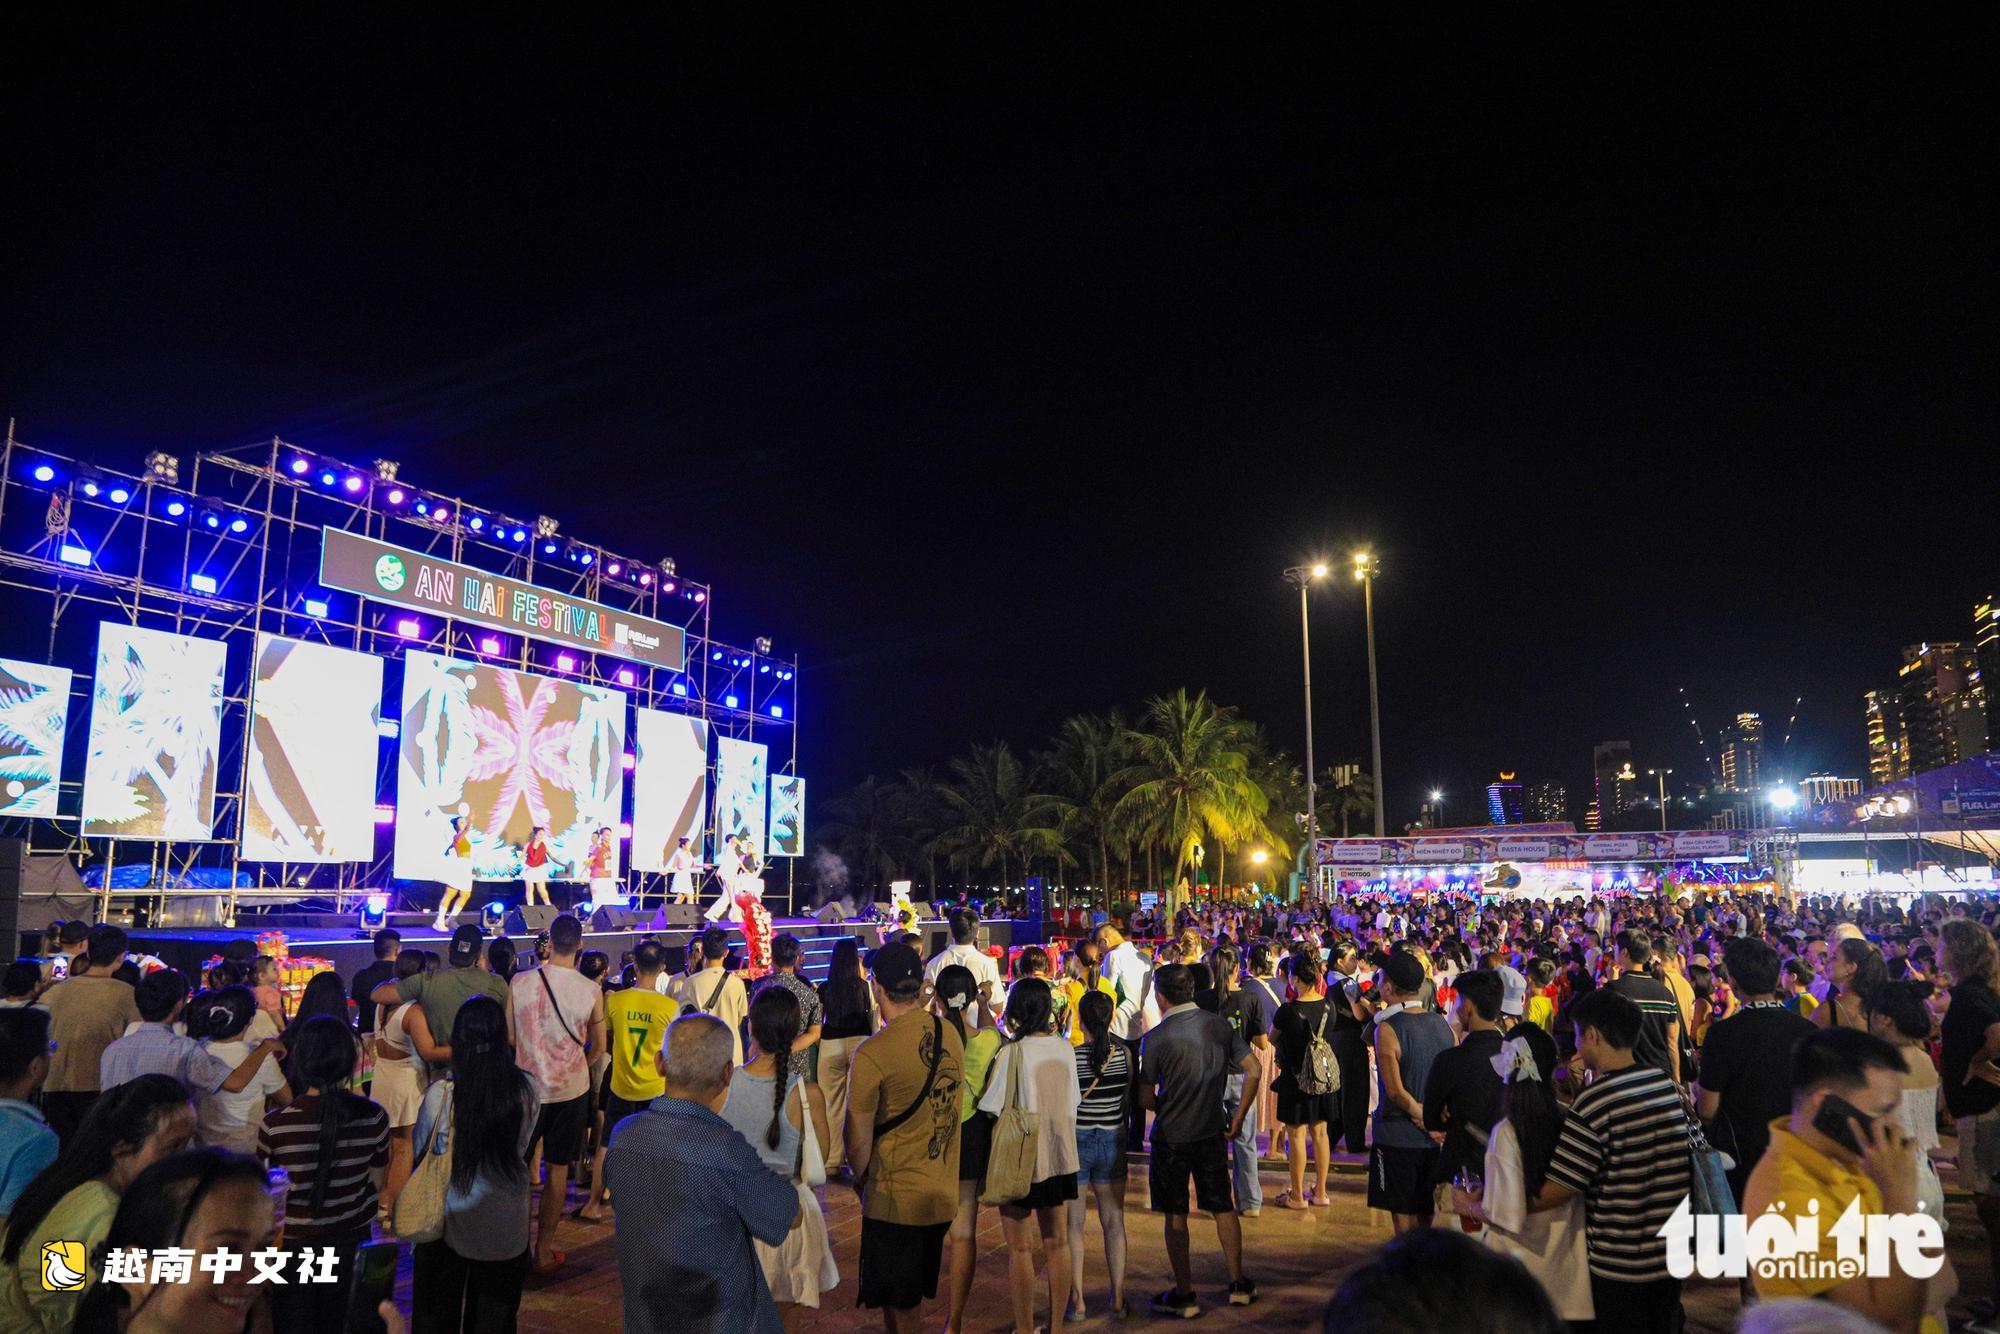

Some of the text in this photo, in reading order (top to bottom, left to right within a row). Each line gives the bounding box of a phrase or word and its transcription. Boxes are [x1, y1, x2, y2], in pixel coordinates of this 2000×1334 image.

[414, 565, 454, 605] AN
[512, 590, 610, 648] FESTIVAL
[1523, 845, 1546, 853] HOUSE
[627, 1011, 654, 1024] LIXIL
[628, 1027, 648, 1068] 7
